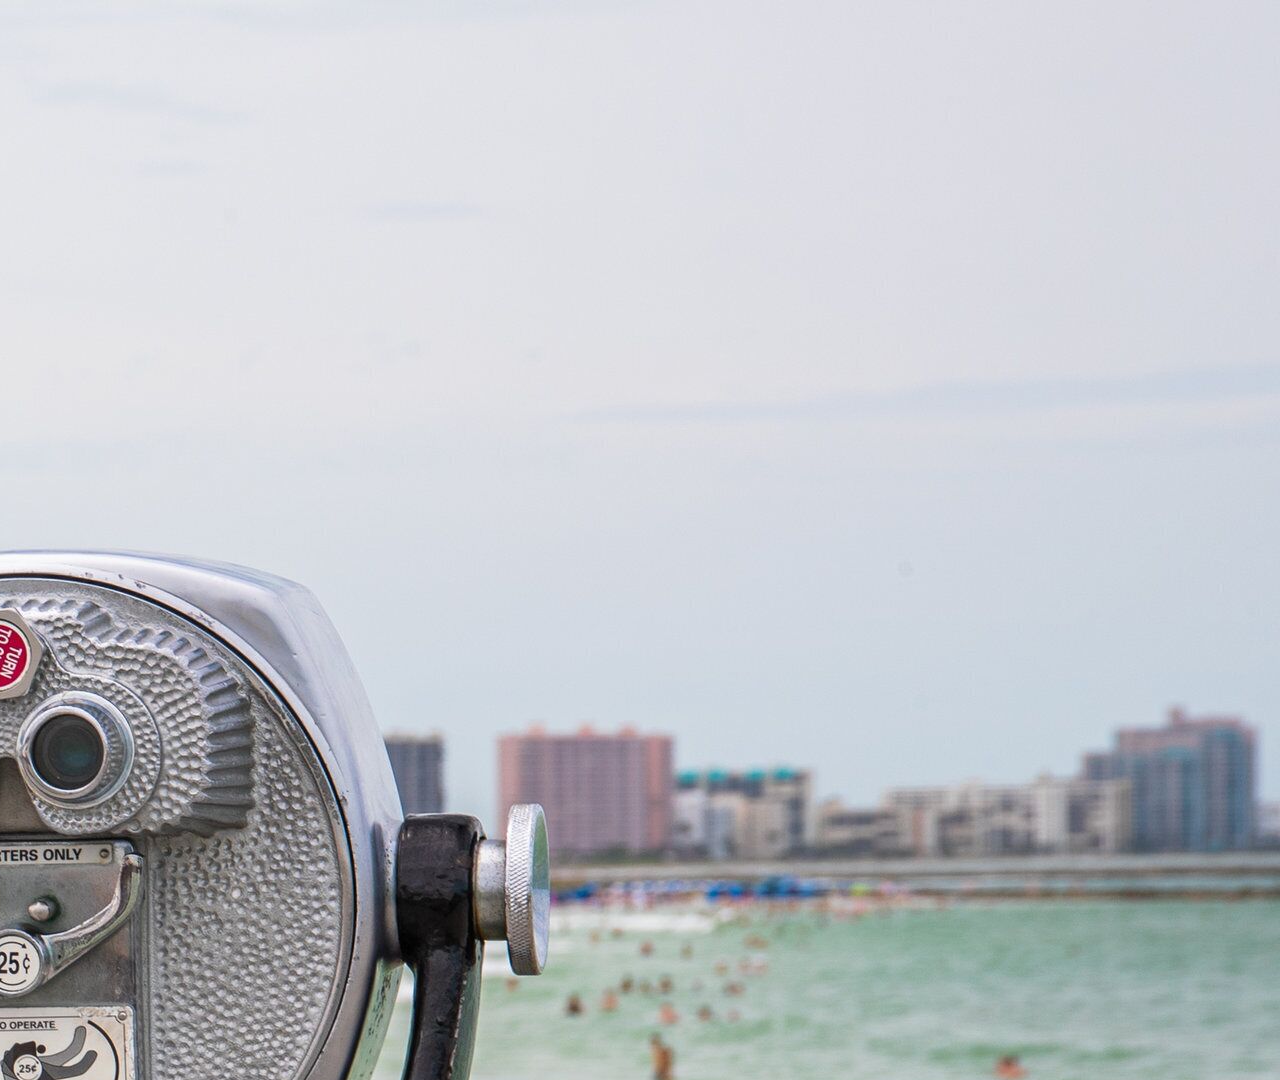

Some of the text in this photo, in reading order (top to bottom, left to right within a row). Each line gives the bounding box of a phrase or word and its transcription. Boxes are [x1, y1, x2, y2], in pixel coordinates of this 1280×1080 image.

[0, 647, 22, 679] TURN
[43, 848, 82, 861] ONLY
[10, 1021, 56, 1030] OPERATE
[19, 1063, 37, 1074] 25¢
